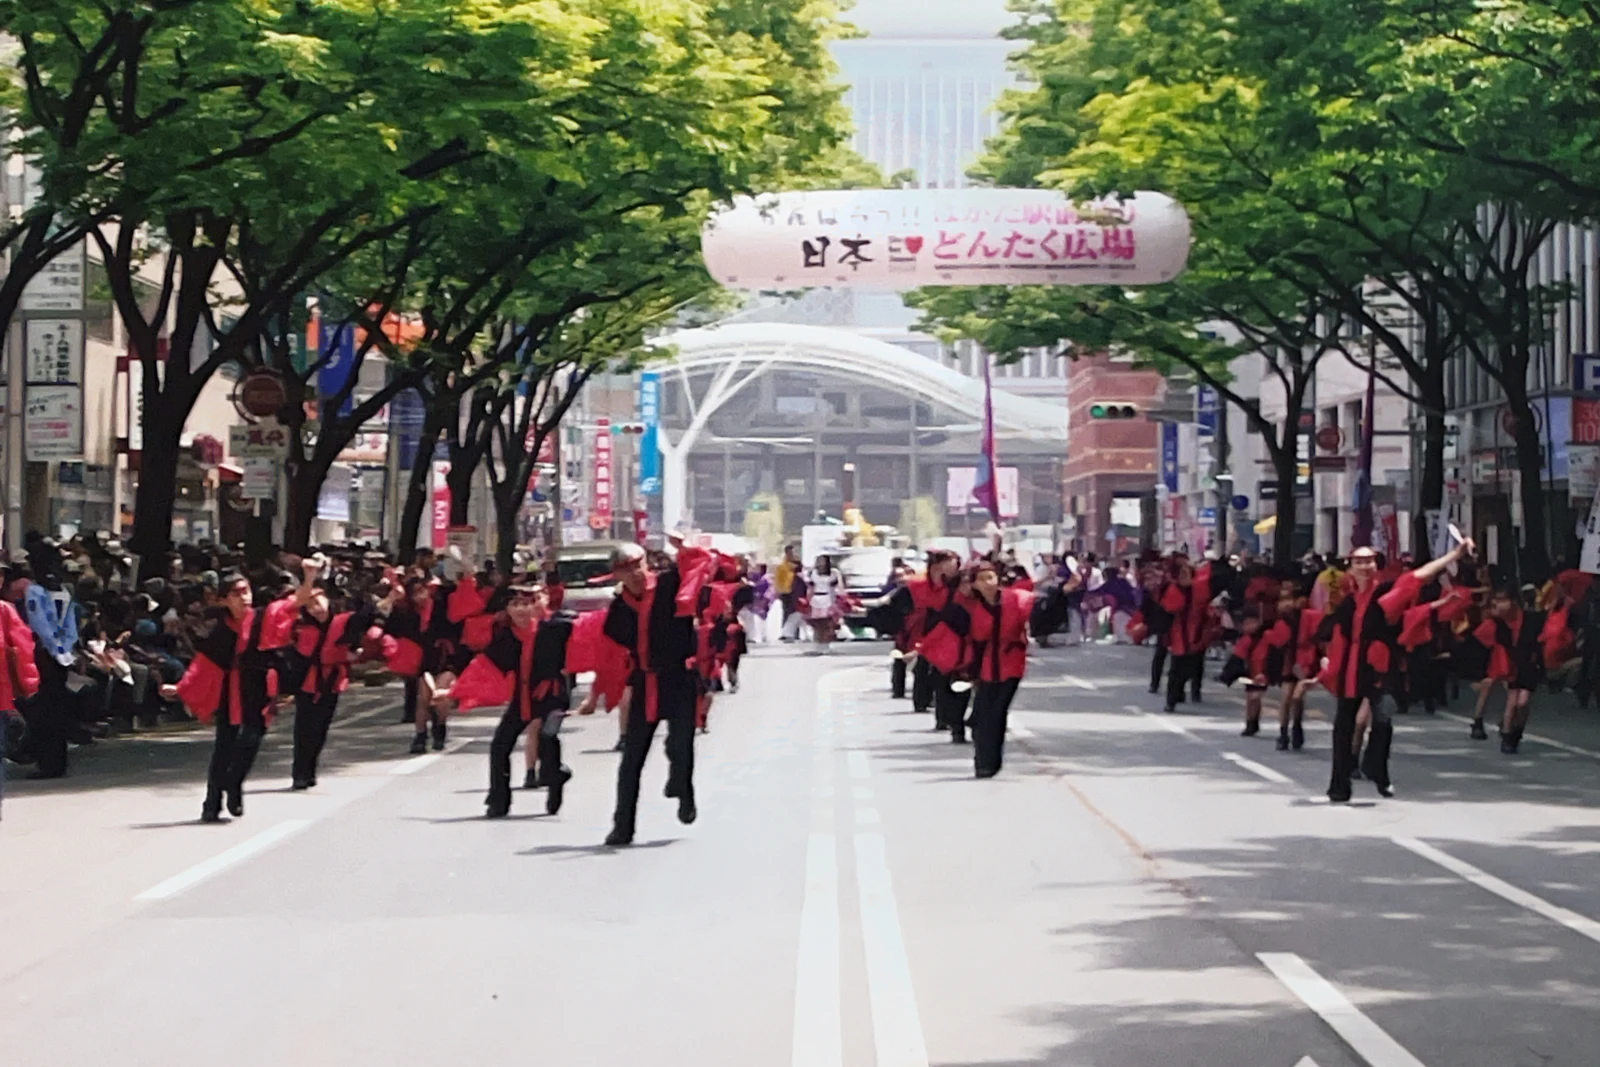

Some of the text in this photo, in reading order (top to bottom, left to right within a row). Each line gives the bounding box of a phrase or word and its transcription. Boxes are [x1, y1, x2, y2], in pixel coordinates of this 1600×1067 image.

[801, 233, 876, 271] 日本
[932, 229, 1137, 260] どんたく広場
